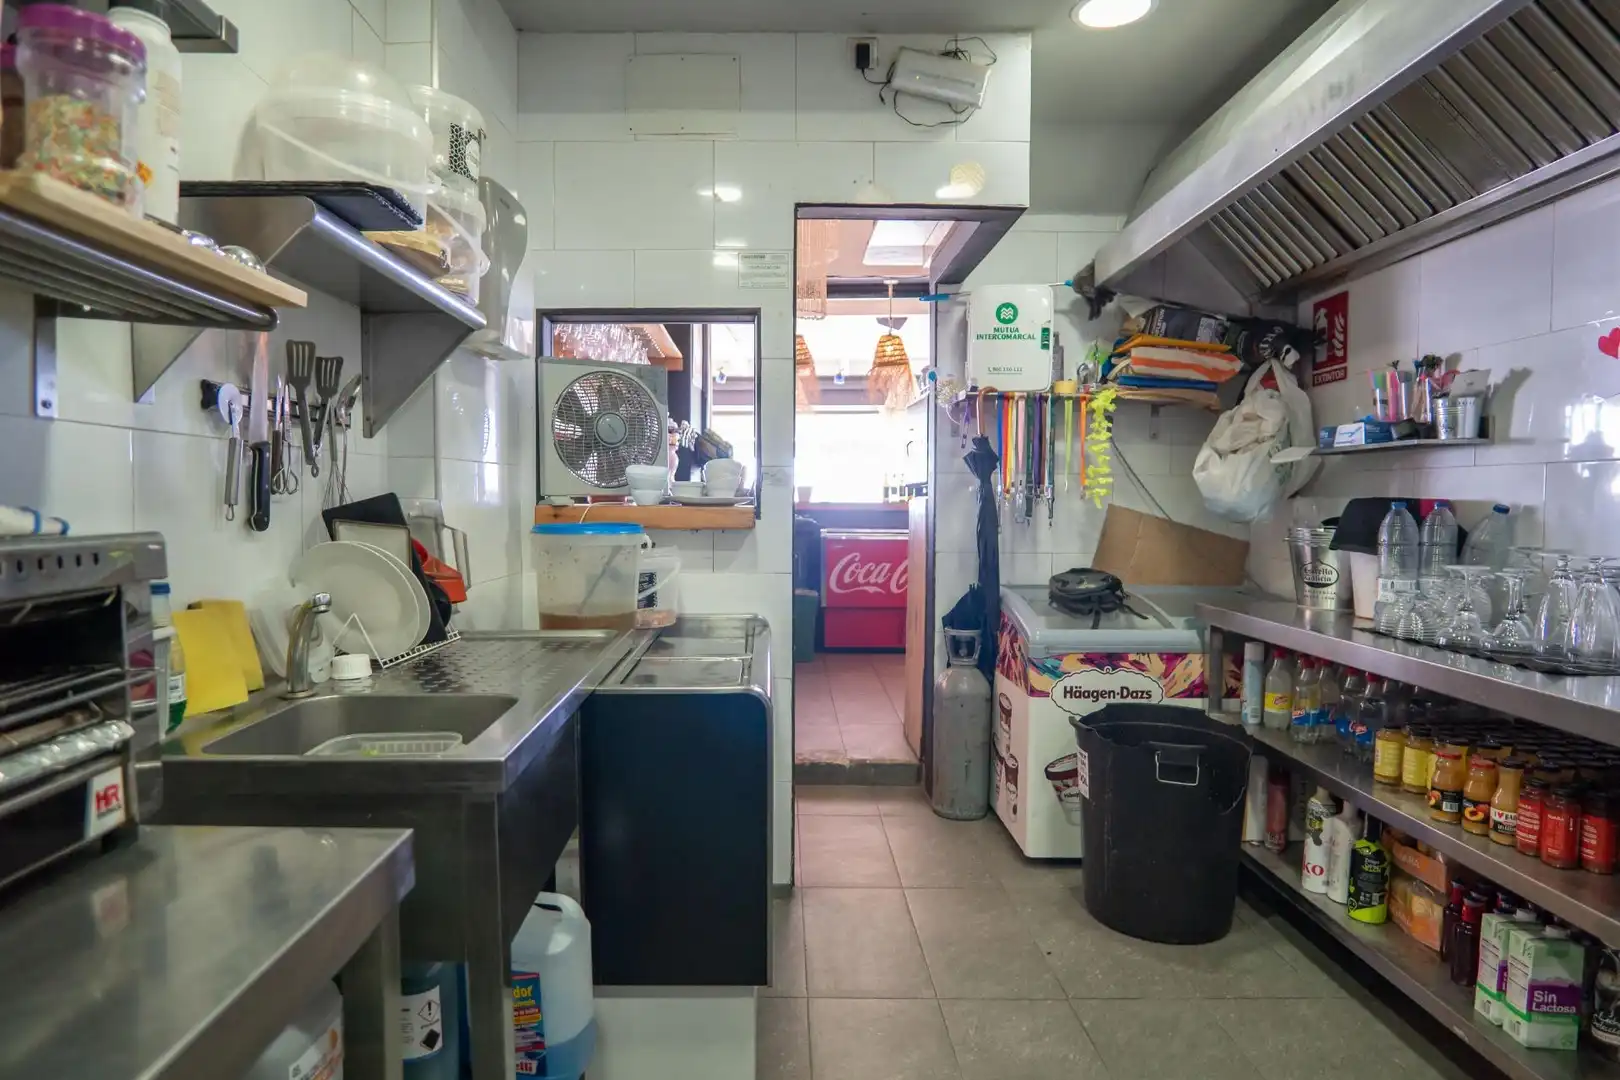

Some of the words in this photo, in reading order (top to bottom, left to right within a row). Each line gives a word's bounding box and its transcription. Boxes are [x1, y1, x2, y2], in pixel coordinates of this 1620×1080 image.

[1314, 371, 1345, 384] EXTINTOR
[1533, 990, 1557, 1004] Sin
[1532, 1003, 1576, 1013] Lactosa
